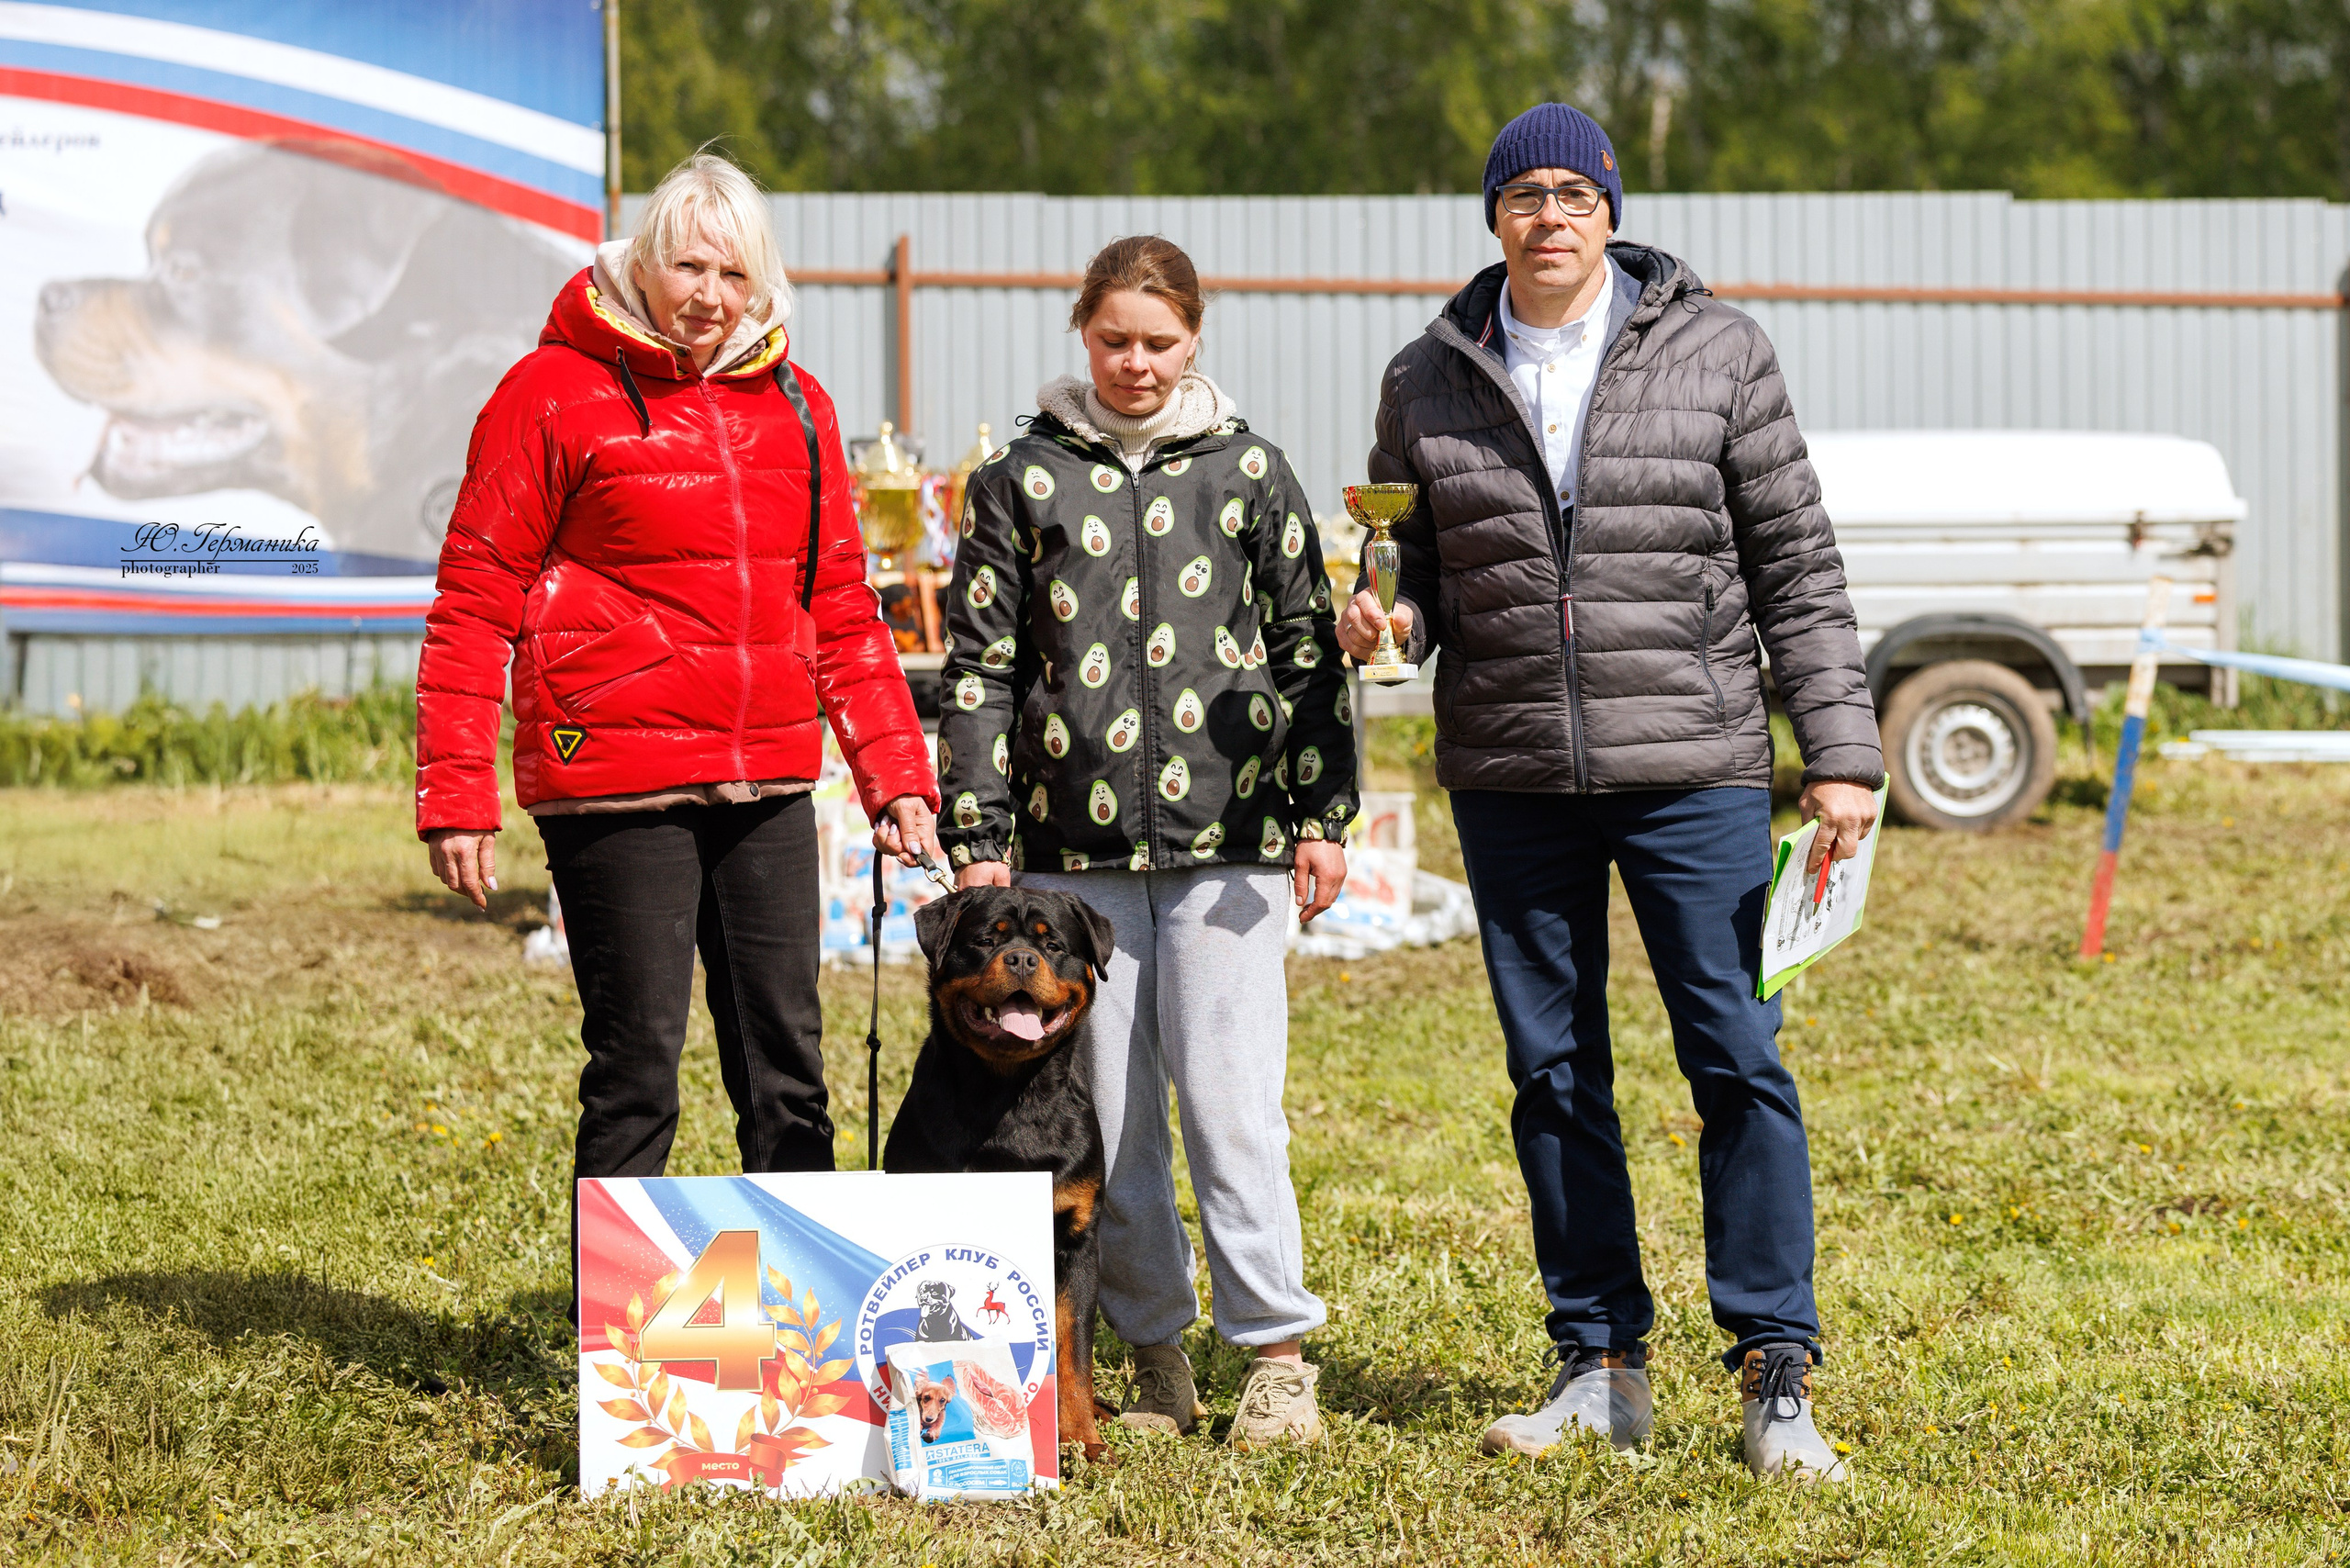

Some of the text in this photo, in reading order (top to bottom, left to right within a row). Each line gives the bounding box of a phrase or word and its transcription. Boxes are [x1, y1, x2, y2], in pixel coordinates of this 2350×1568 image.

[639, 1228, 778, 1393] 4
[860, 1248, 1048, 1355] РОТВЕЙЛЕР КЛУБ РОССИИ
[701, 1461, 740, 1471] место
[935, 1442, 990, 1458] STATERA
